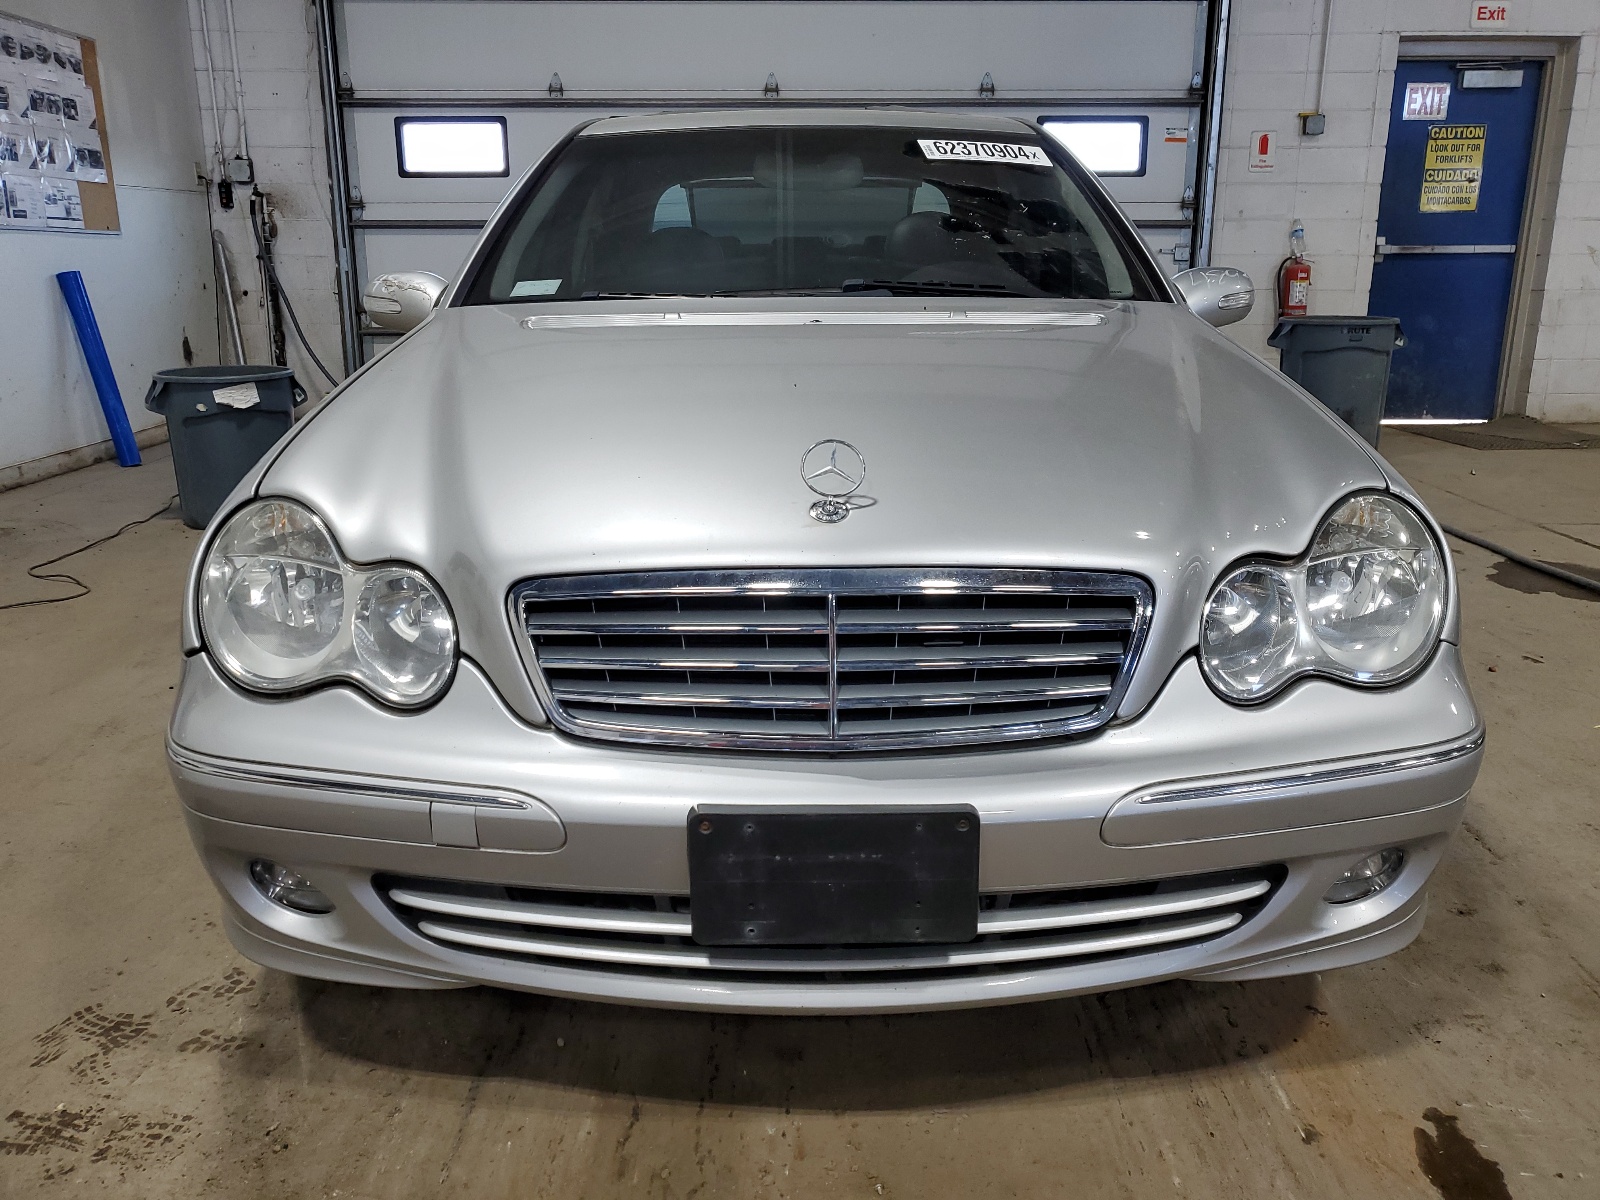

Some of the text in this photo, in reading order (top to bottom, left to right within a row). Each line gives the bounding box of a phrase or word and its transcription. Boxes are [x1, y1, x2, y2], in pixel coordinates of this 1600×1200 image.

[1477, 6, 1506, 20] Exit
[1406, 86, 1447, 115] EXIT
[1431, 127, 1485, 139] CAUTION
[933, 141, 1031, 160] 62370904
[1430, 143, 1481, 153] LOOK OUT FOR
[1435, 155, 1473, 164] FORKLIFTS
[1425, 169, 1479, 181] CUIDADO
